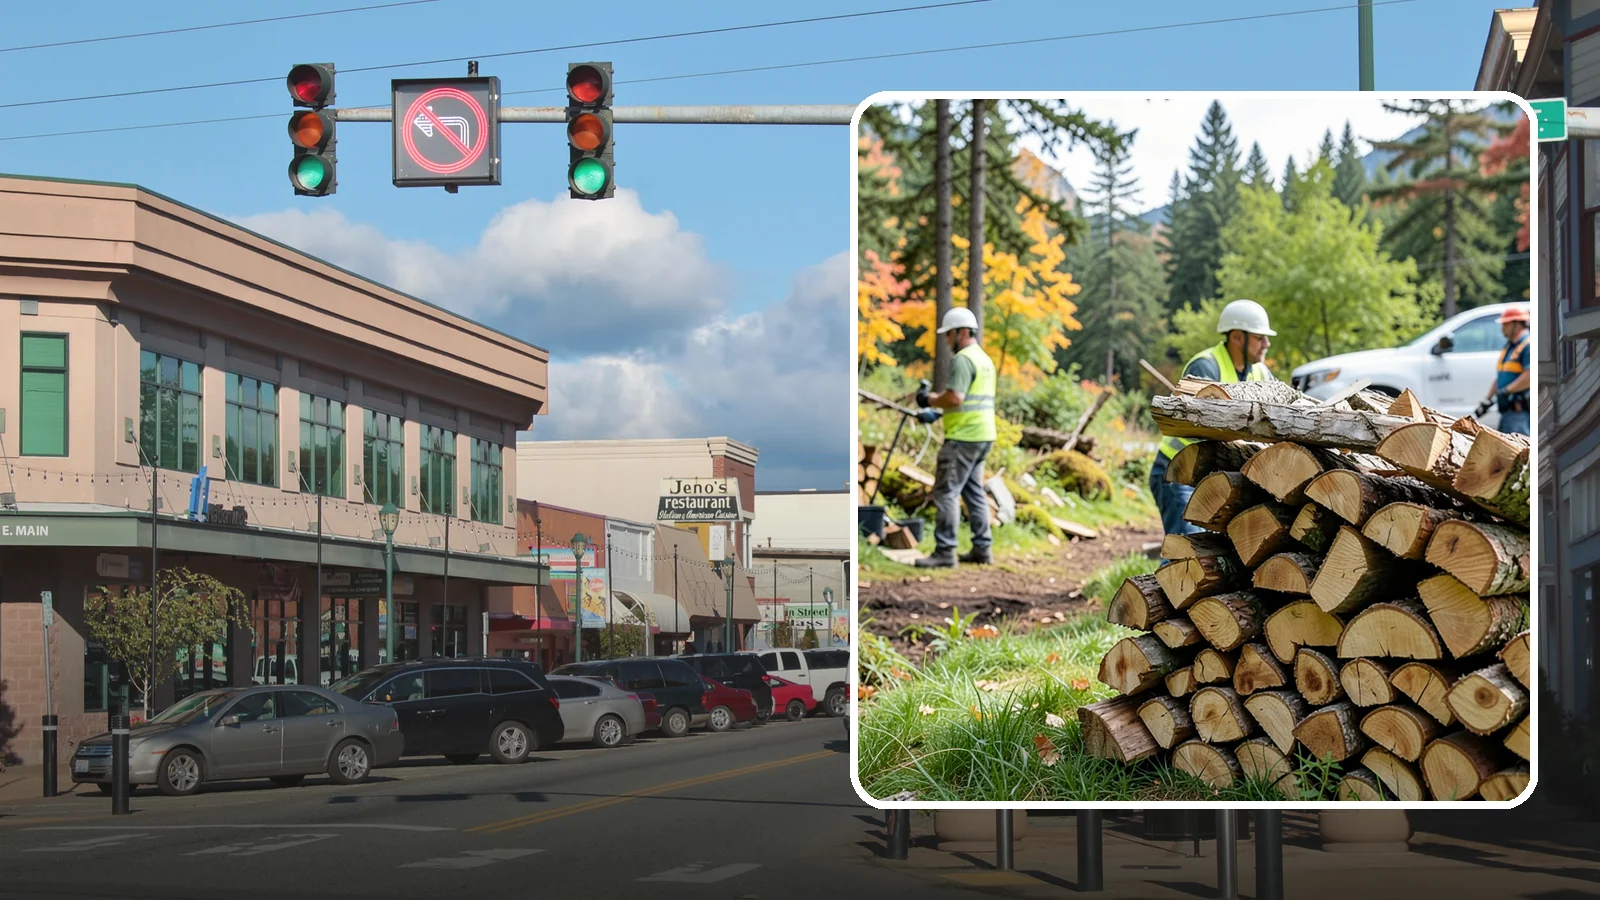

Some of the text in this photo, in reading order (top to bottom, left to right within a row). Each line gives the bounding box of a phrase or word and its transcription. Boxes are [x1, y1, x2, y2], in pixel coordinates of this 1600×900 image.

[669, 480, 728, 494] Jeno's
[665, 496, 731, 509] restaurant
[658, 510, 681, 520] Italian
[686, 510, 715, 520] American
[715, 509, 738, 520] Cuisine
[2, 525, 49, 536] E. MAIN
[797, 607, 828, 616] Street
[790, 619, 823, 627] lass
